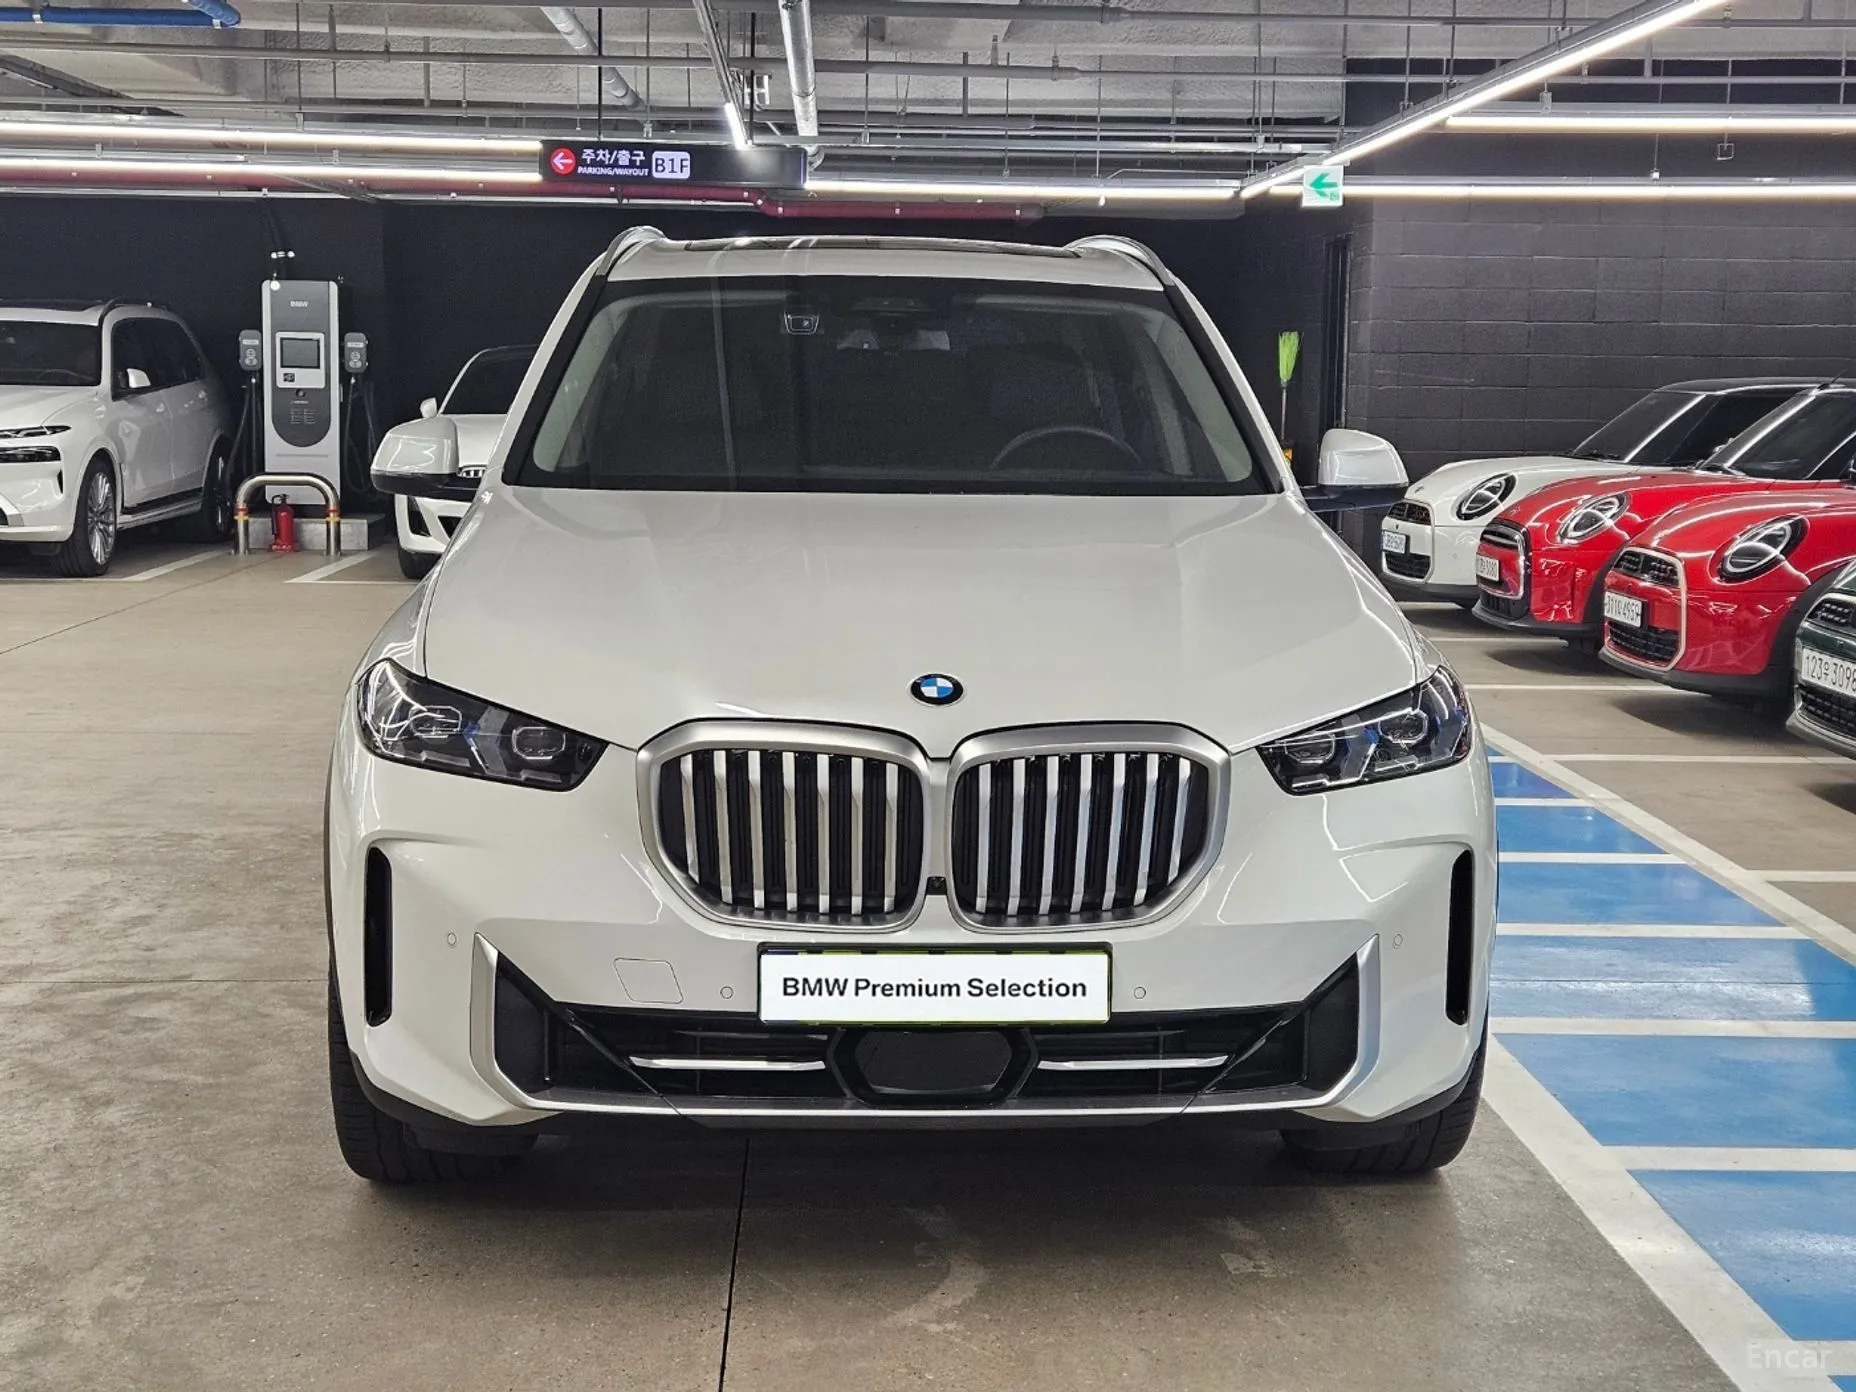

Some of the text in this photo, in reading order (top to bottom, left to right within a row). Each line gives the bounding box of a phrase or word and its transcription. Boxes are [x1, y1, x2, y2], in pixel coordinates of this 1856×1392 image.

[582, 148, 646, 166] 주차/출구
[654, 157, 689, 174] B1F
[577, 165, 649, 176] PARKING/WAYOUT
[782, 977, 1087, 997] BMW Premium Selection
